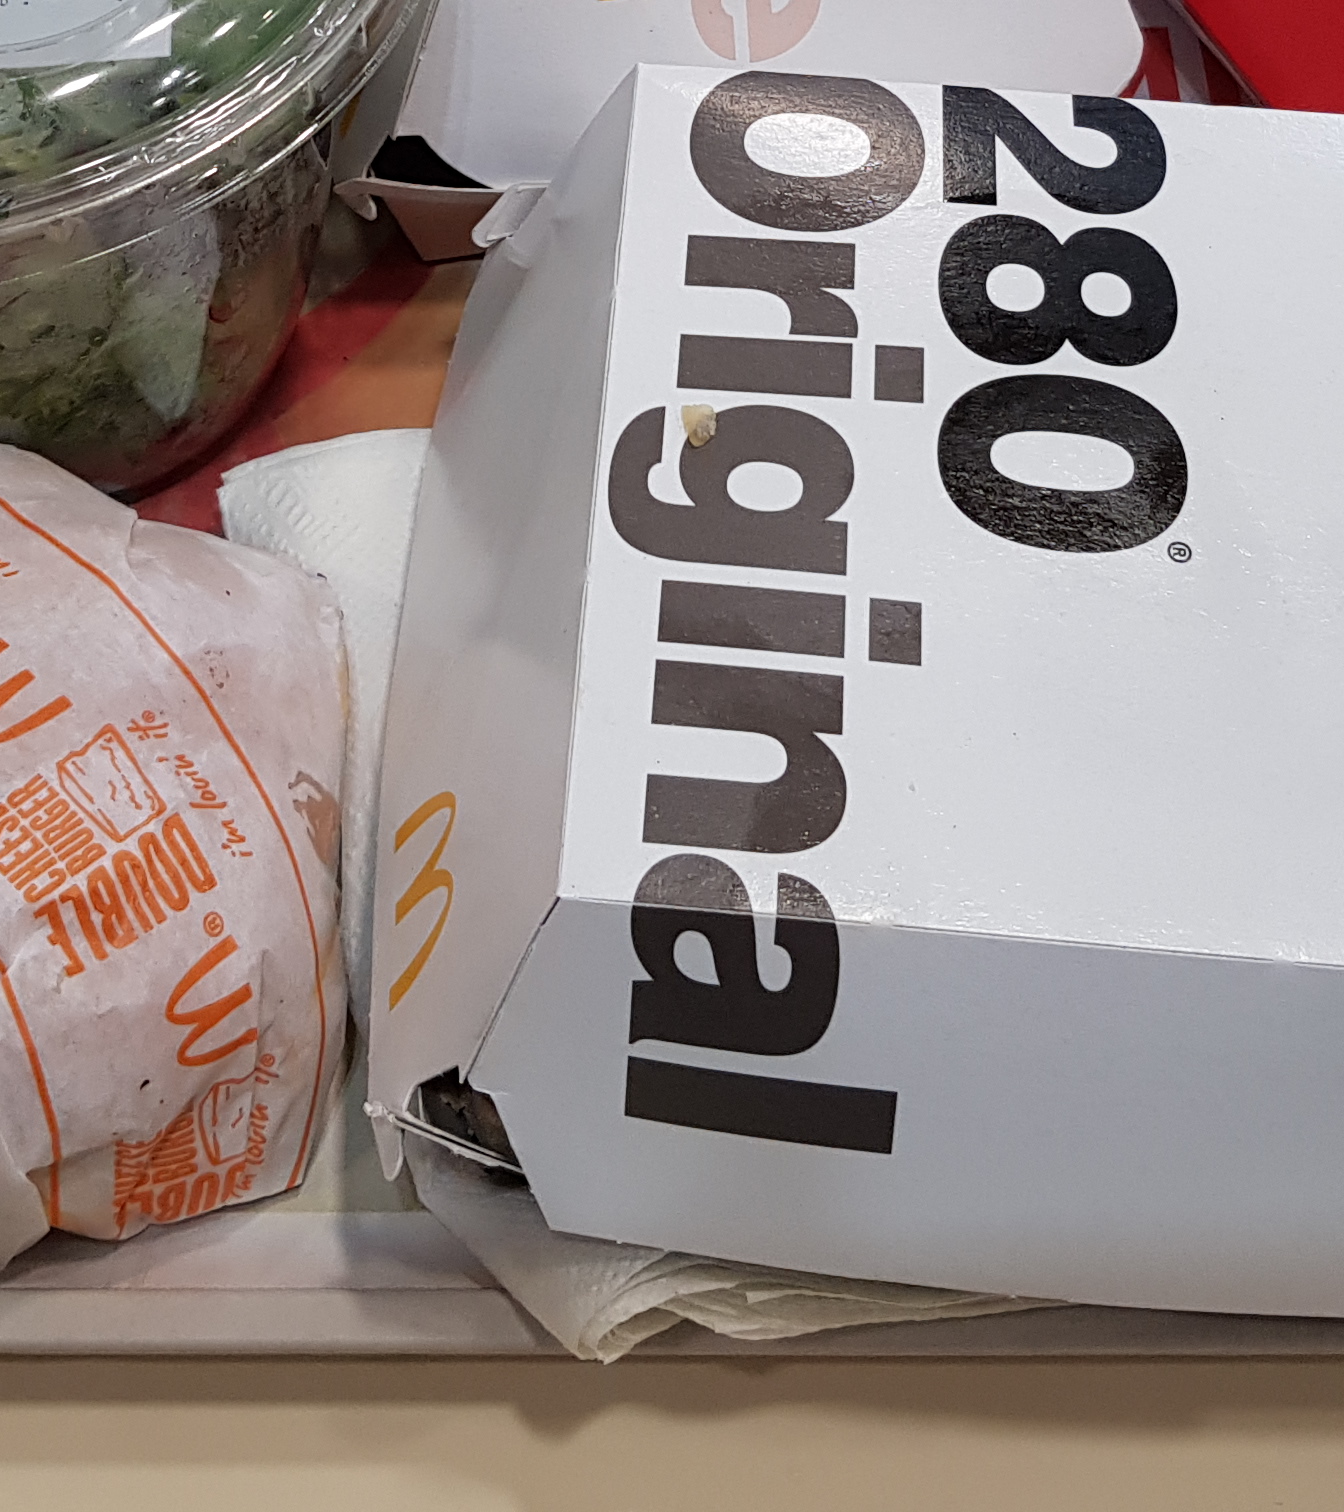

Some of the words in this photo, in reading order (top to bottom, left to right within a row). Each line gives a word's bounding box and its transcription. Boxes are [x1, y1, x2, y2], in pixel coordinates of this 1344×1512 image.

[607, 70, 926, 1154] Original
[6, 772, 108, 877] BURGER
[32, 812, 218, 978] DOUBLE
